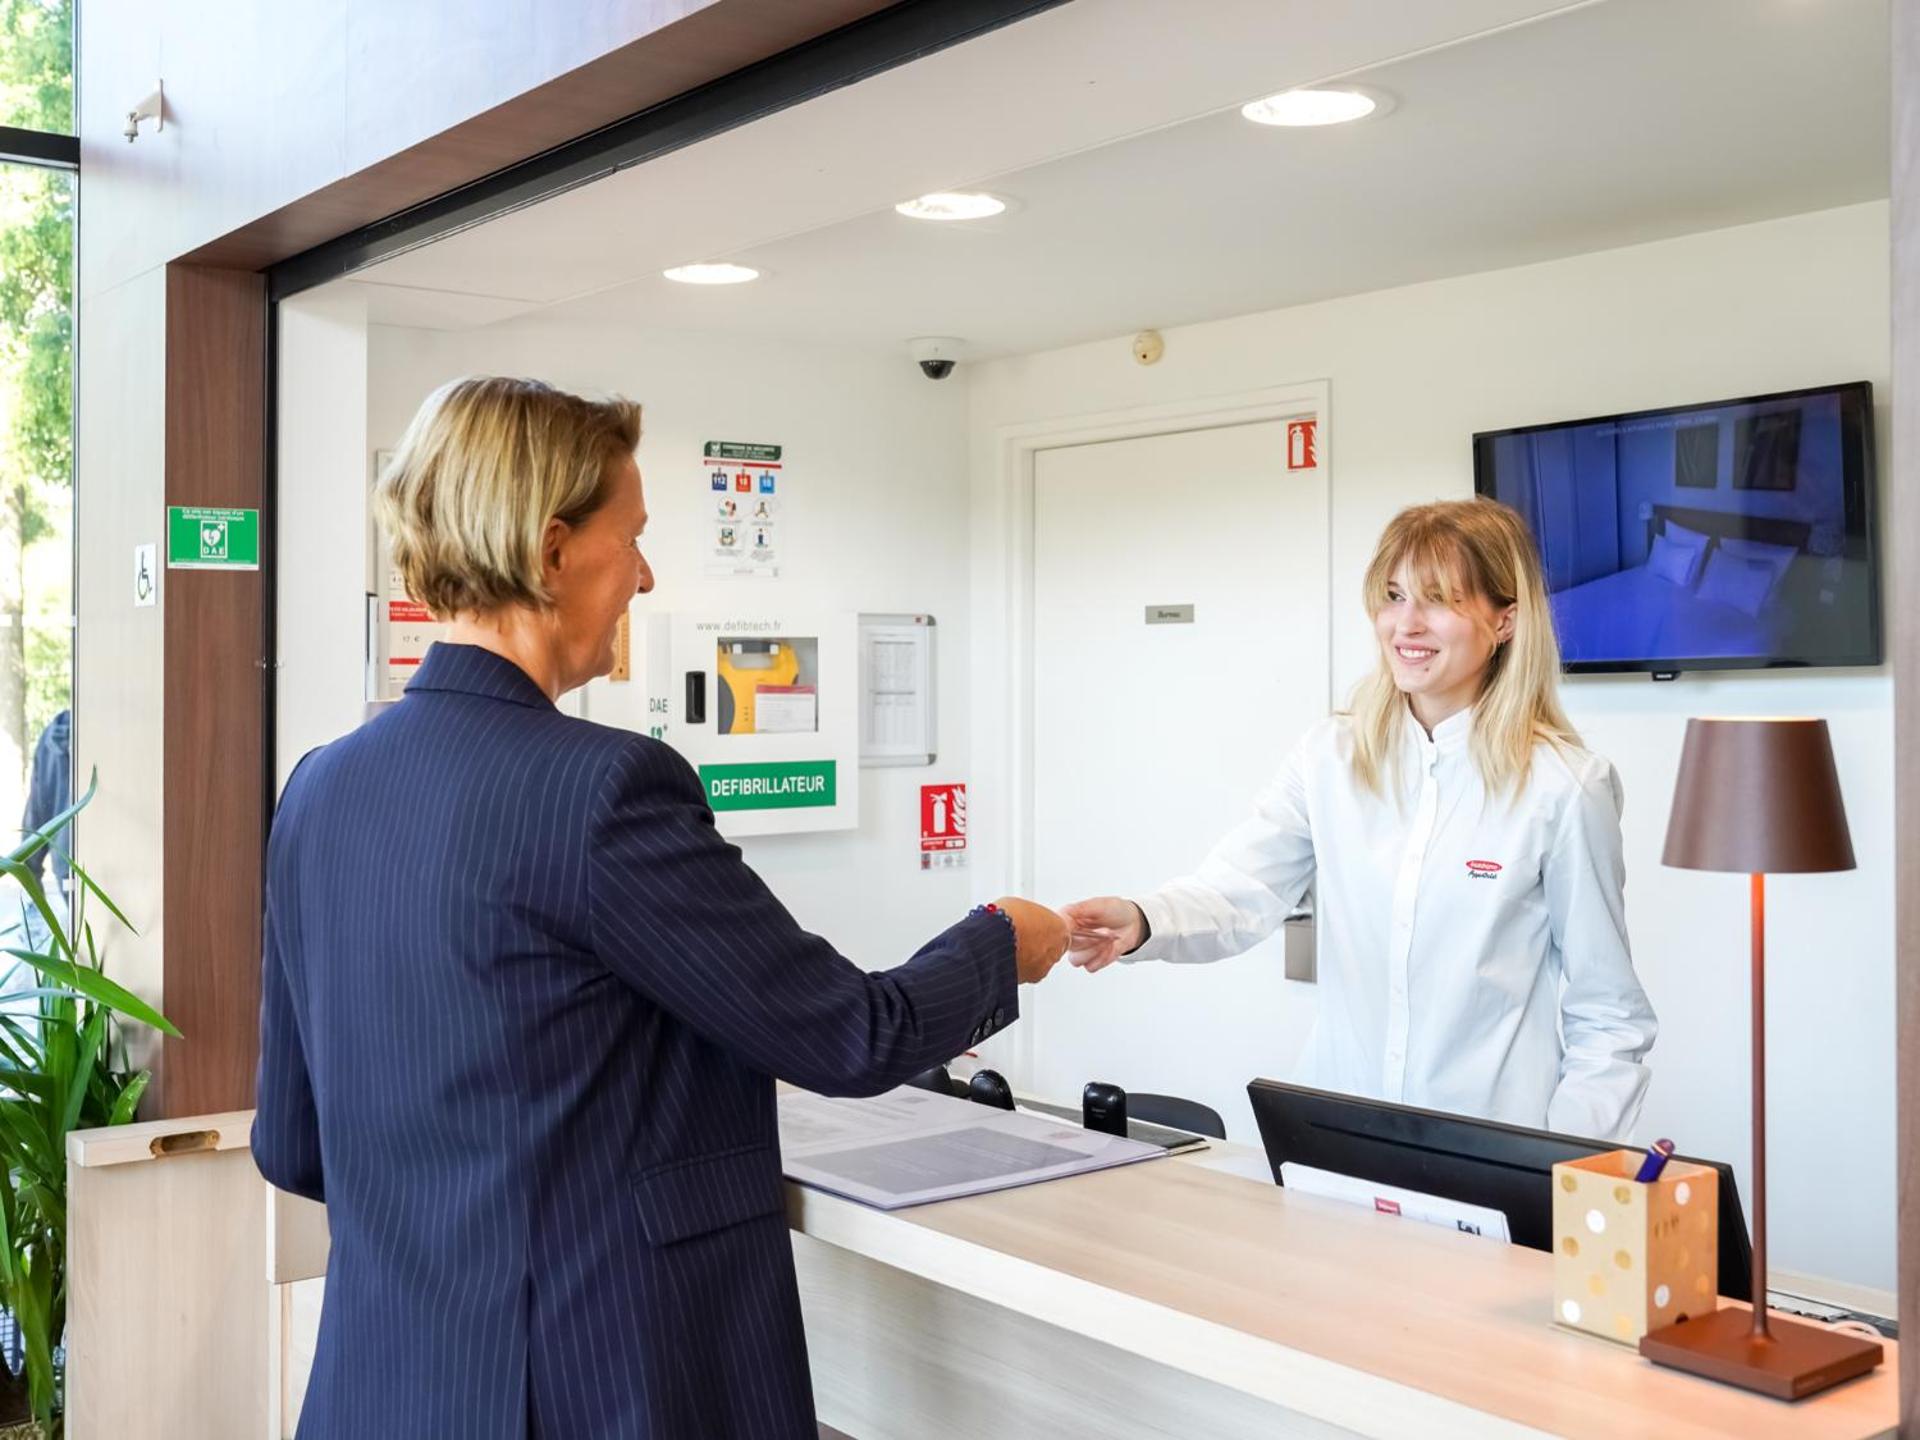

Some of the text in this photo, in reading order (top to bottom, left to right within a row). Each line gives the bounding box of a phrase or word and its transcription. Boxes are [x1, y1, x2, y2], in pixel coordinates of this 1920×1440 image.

[696, 620, 782, 632] www.defibtech.fr
[649, 697, 669, 713] DAE
[711, 775, 825, 797] DEFIBRILLATEUR
